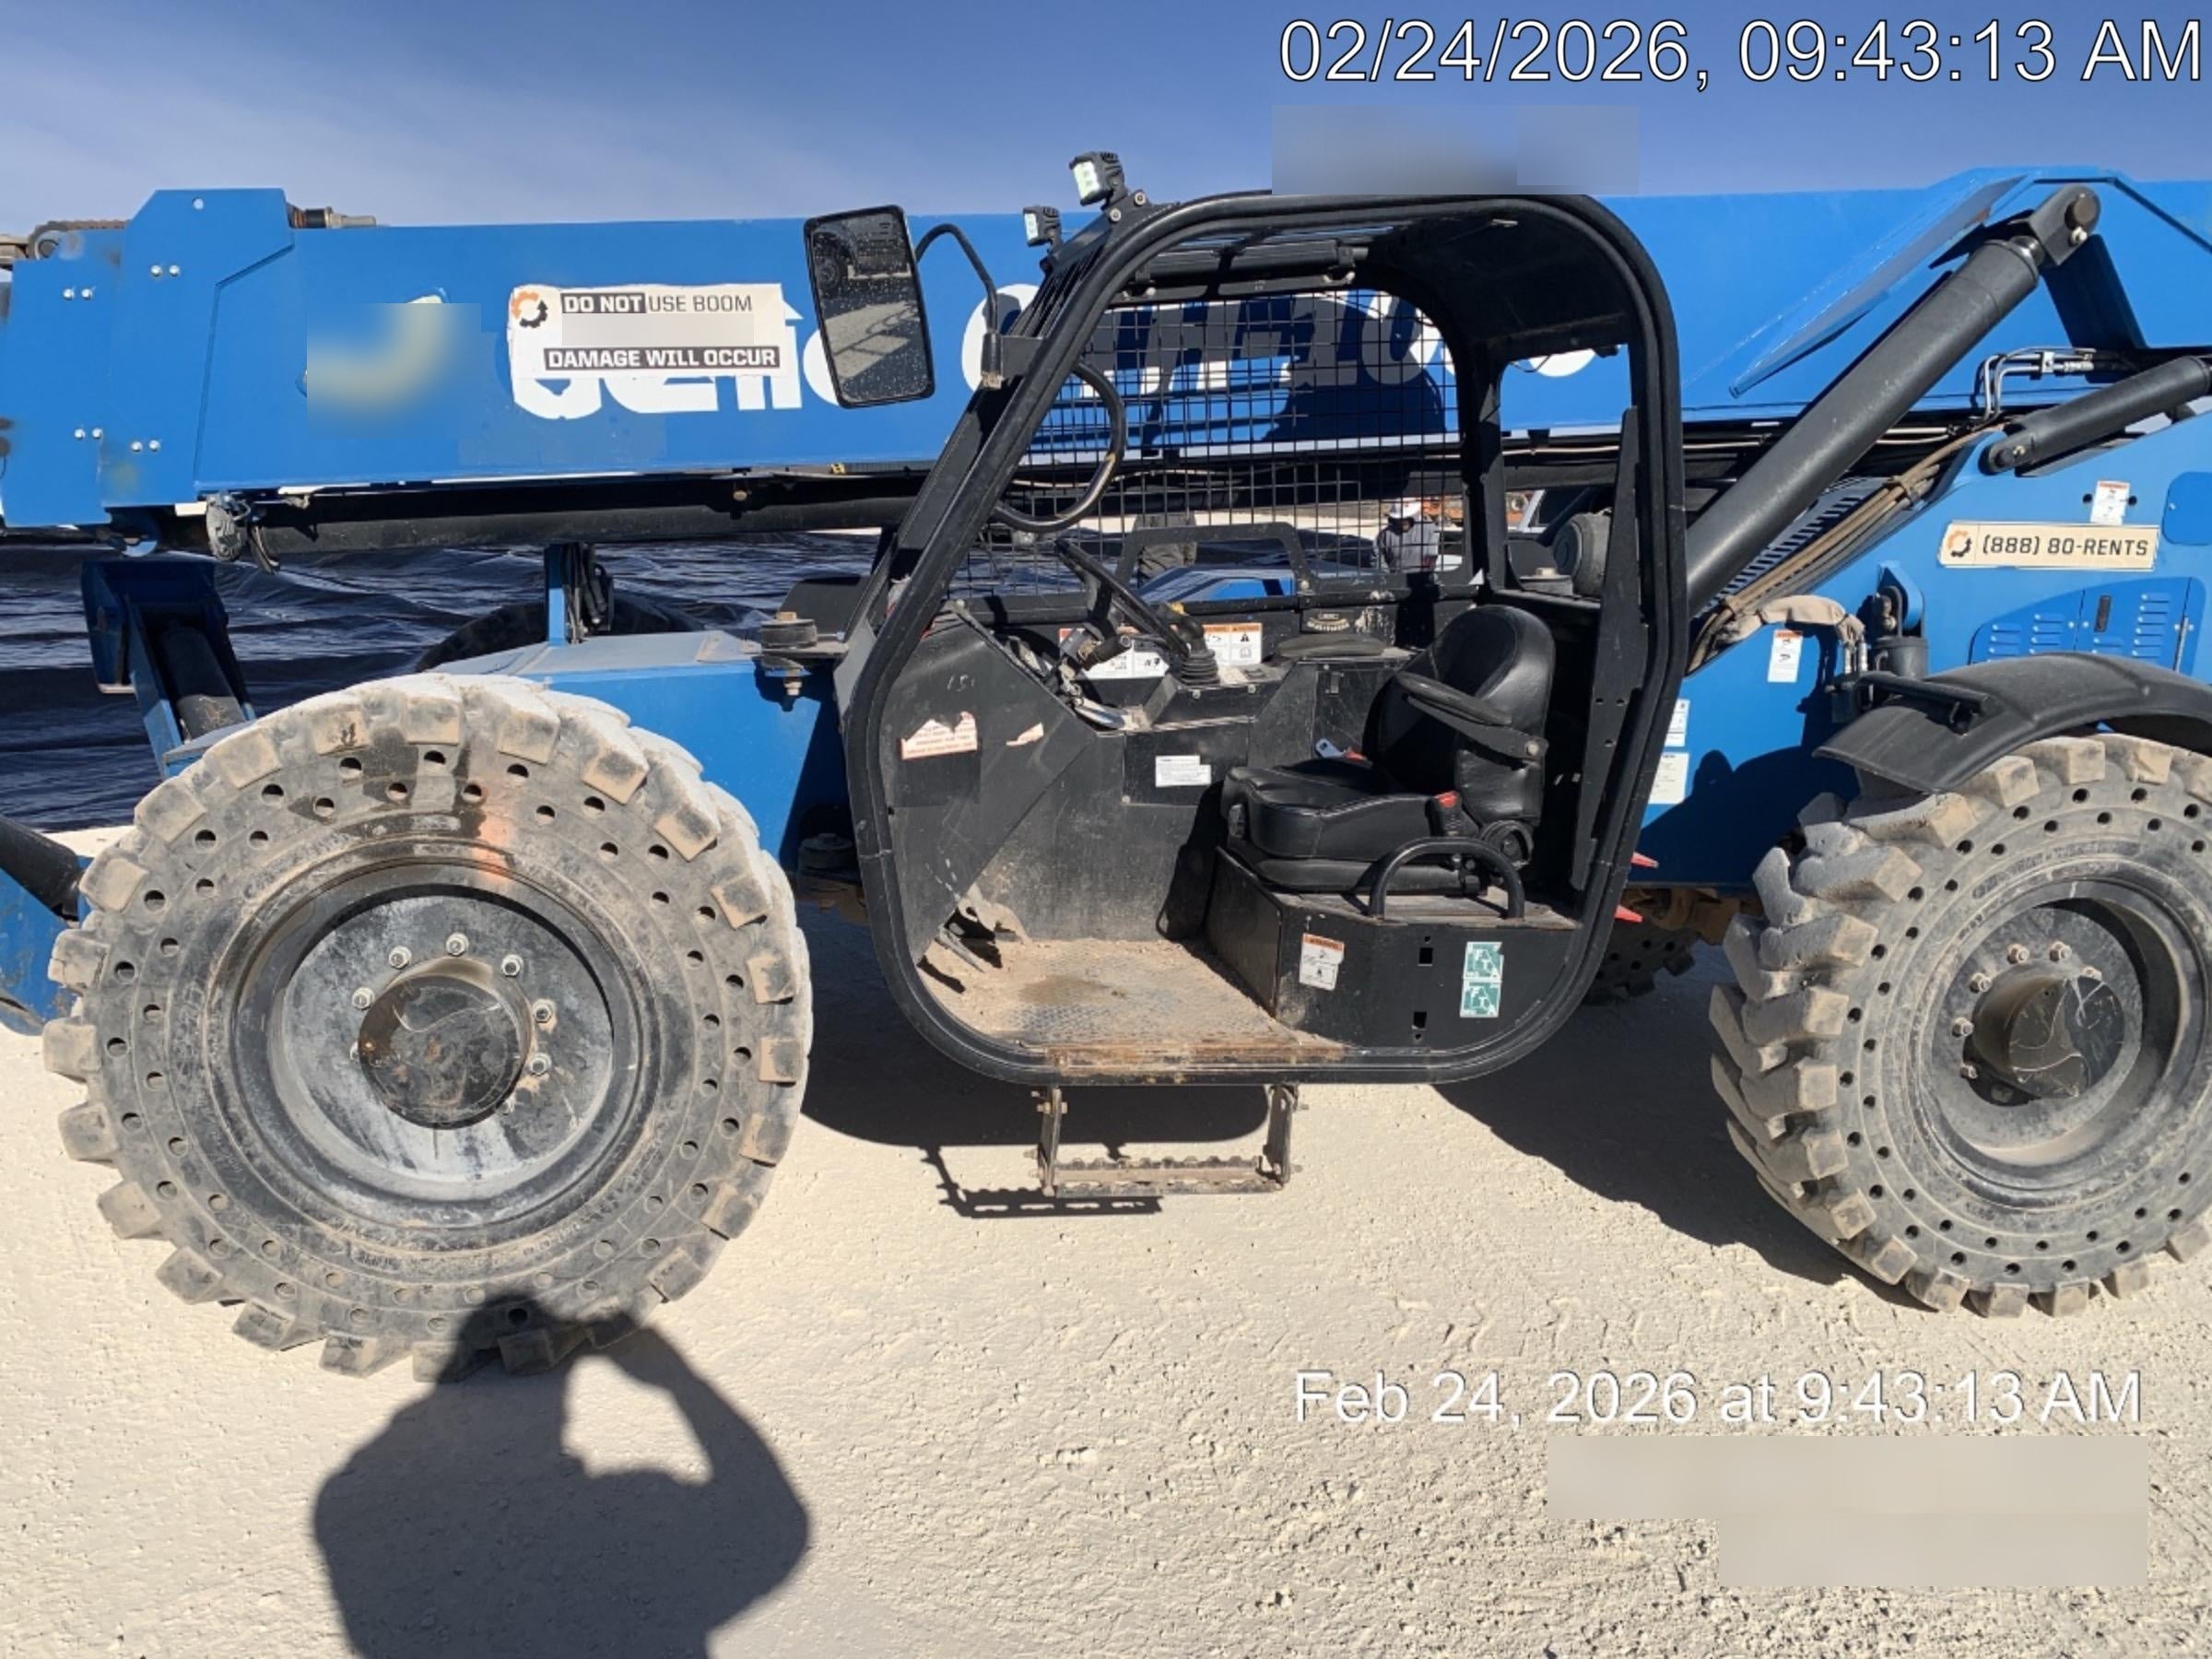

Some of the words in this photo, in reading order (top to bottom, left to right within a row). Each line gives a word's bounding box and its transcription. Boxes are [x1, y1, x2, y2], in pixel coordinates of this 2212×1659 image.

[564, 295, 594, 312] DO
[600, 295, 642, 312] NOT
[649, 295, 686, 312] USE
[693, 295, 752, 312] BOOM
[547, 349, 641, 369] DAMAGE
[646, 349, 700, 367] WILL
[703, 348, 778, 367] OCCUR
[1983, 535, 2040, 554] (888)
[2047, 537, 2148, 556] 80-RENTS
